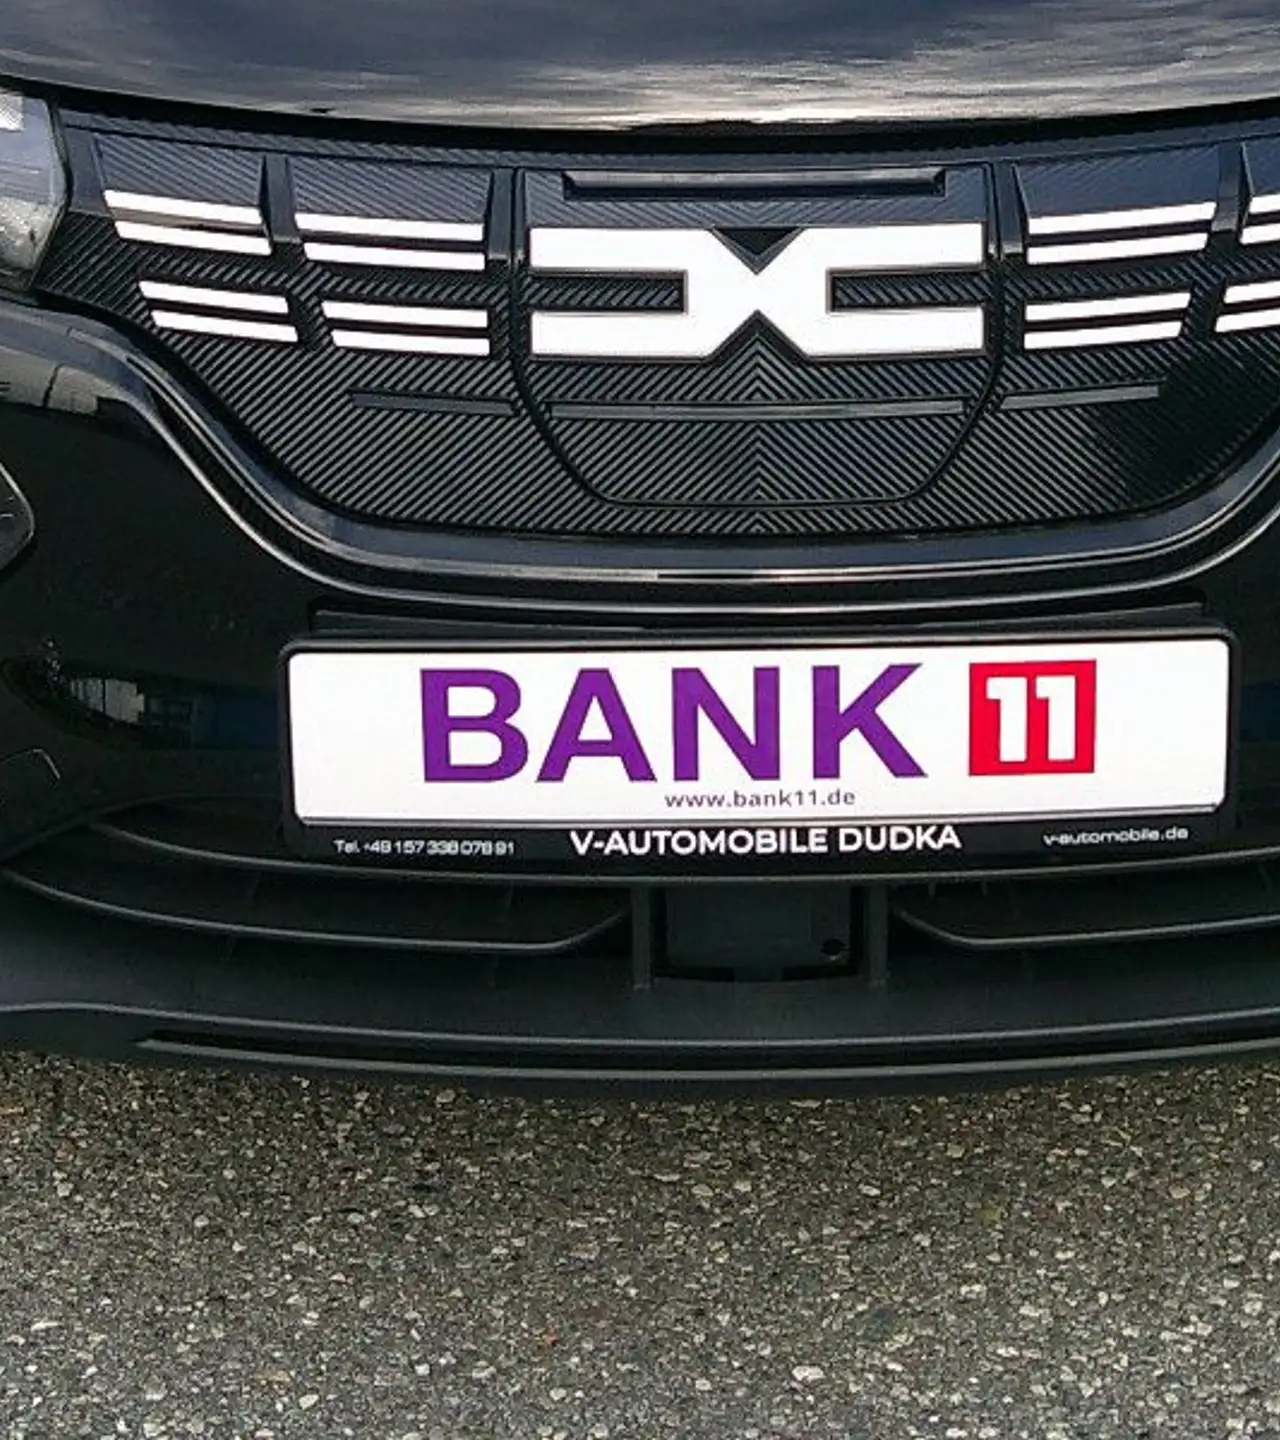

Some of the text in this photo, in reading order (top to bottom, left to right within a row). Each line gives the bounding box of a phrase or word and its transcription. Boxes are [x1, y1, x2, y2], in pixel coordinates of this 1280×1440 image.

[421, 664, 1077, 782] BANK 11
[665, 788, 856, 809] www.bank11.de
[569, 825, 962, 855] V-AUTOMOBILE DUDKA
[1042, 826, 1189, 846] v-automobile.de
[334, 839, 361, 854] Tel.
[394, 840, 425, 855] 157
